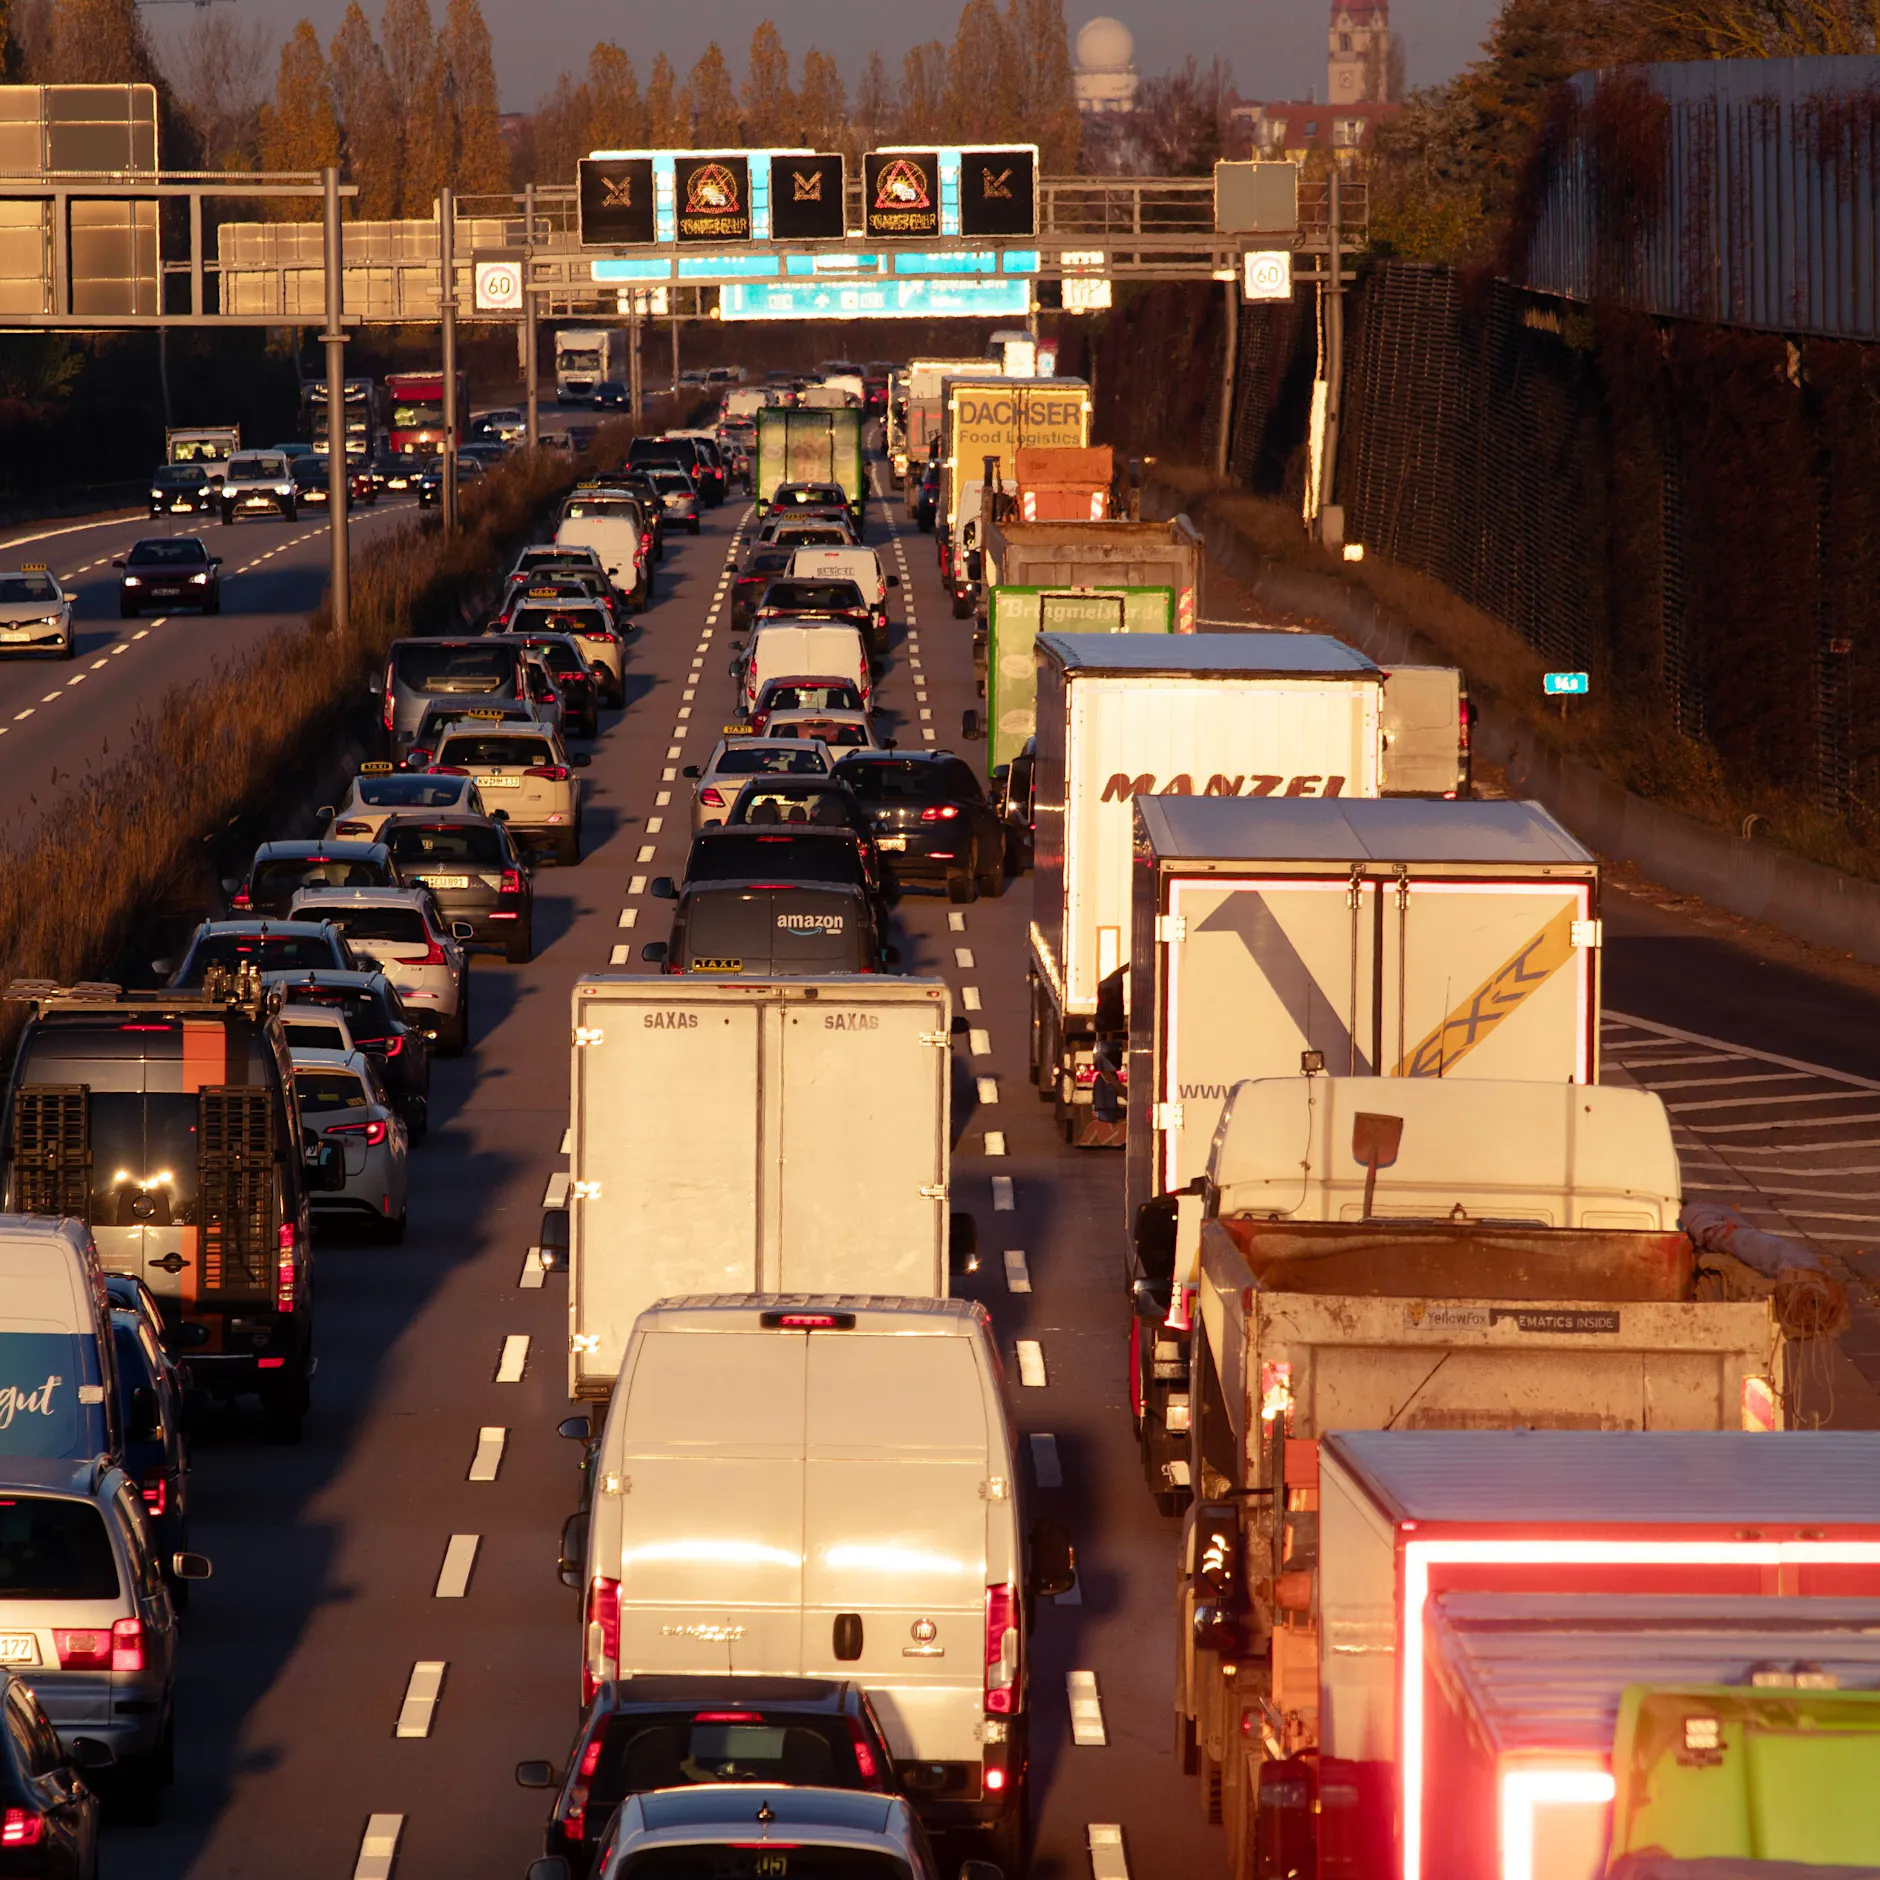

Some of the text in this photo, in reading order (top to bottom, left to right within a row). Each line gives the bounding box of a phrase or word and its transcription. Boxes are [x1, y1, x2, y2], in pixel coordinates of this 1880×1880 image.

[1256, 265, 1279, 284] 60
[488, 277, 510, 295] 60
[959, 401, 1080, 426] DACHSER
[960, 429, 1080, 447] Food Logistics
[1003, 598, 1164, 622] Bringmeister.de
[777, 914, 844, 928] amazon
[700, 959, 735, 968] TAXI
[643, 1012, 698, 1029] SAXAS
[824, 1013, 879, 1031] SAXAS
[1428, 1311, 1486, 1328] YellowFox
[1576, 1316, 1614, 1329] INSIDE
[1, 1639, 29, 1656] 177
